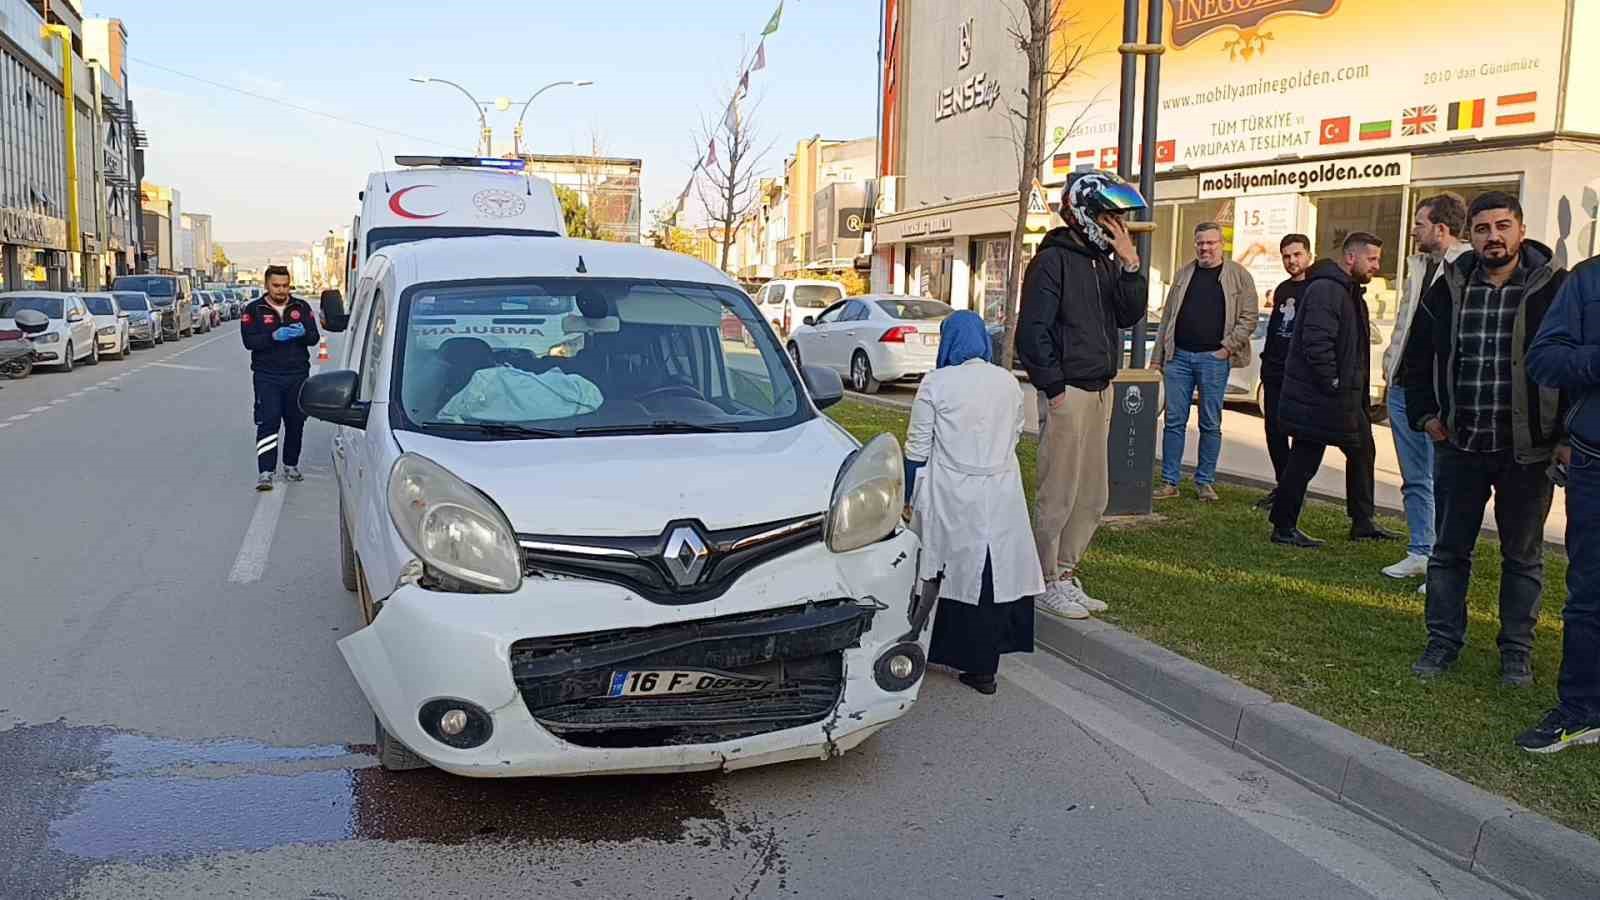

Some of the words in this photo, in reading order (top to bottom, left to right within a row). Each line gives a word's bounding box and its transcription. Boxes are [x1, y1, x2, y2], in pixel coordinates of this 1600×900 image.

[1162, 64, 1369, 111] www.mobilyaminegolden.com
[1211, 119, 1237, 137] TÜM
[1184, 141, 1246, 160] AVRUPAYA
[1203, 161, 1400, 192] mobilyaminegolden.com
[630, 672, 660, 692] 16
[667, 672, 689, 692] F
